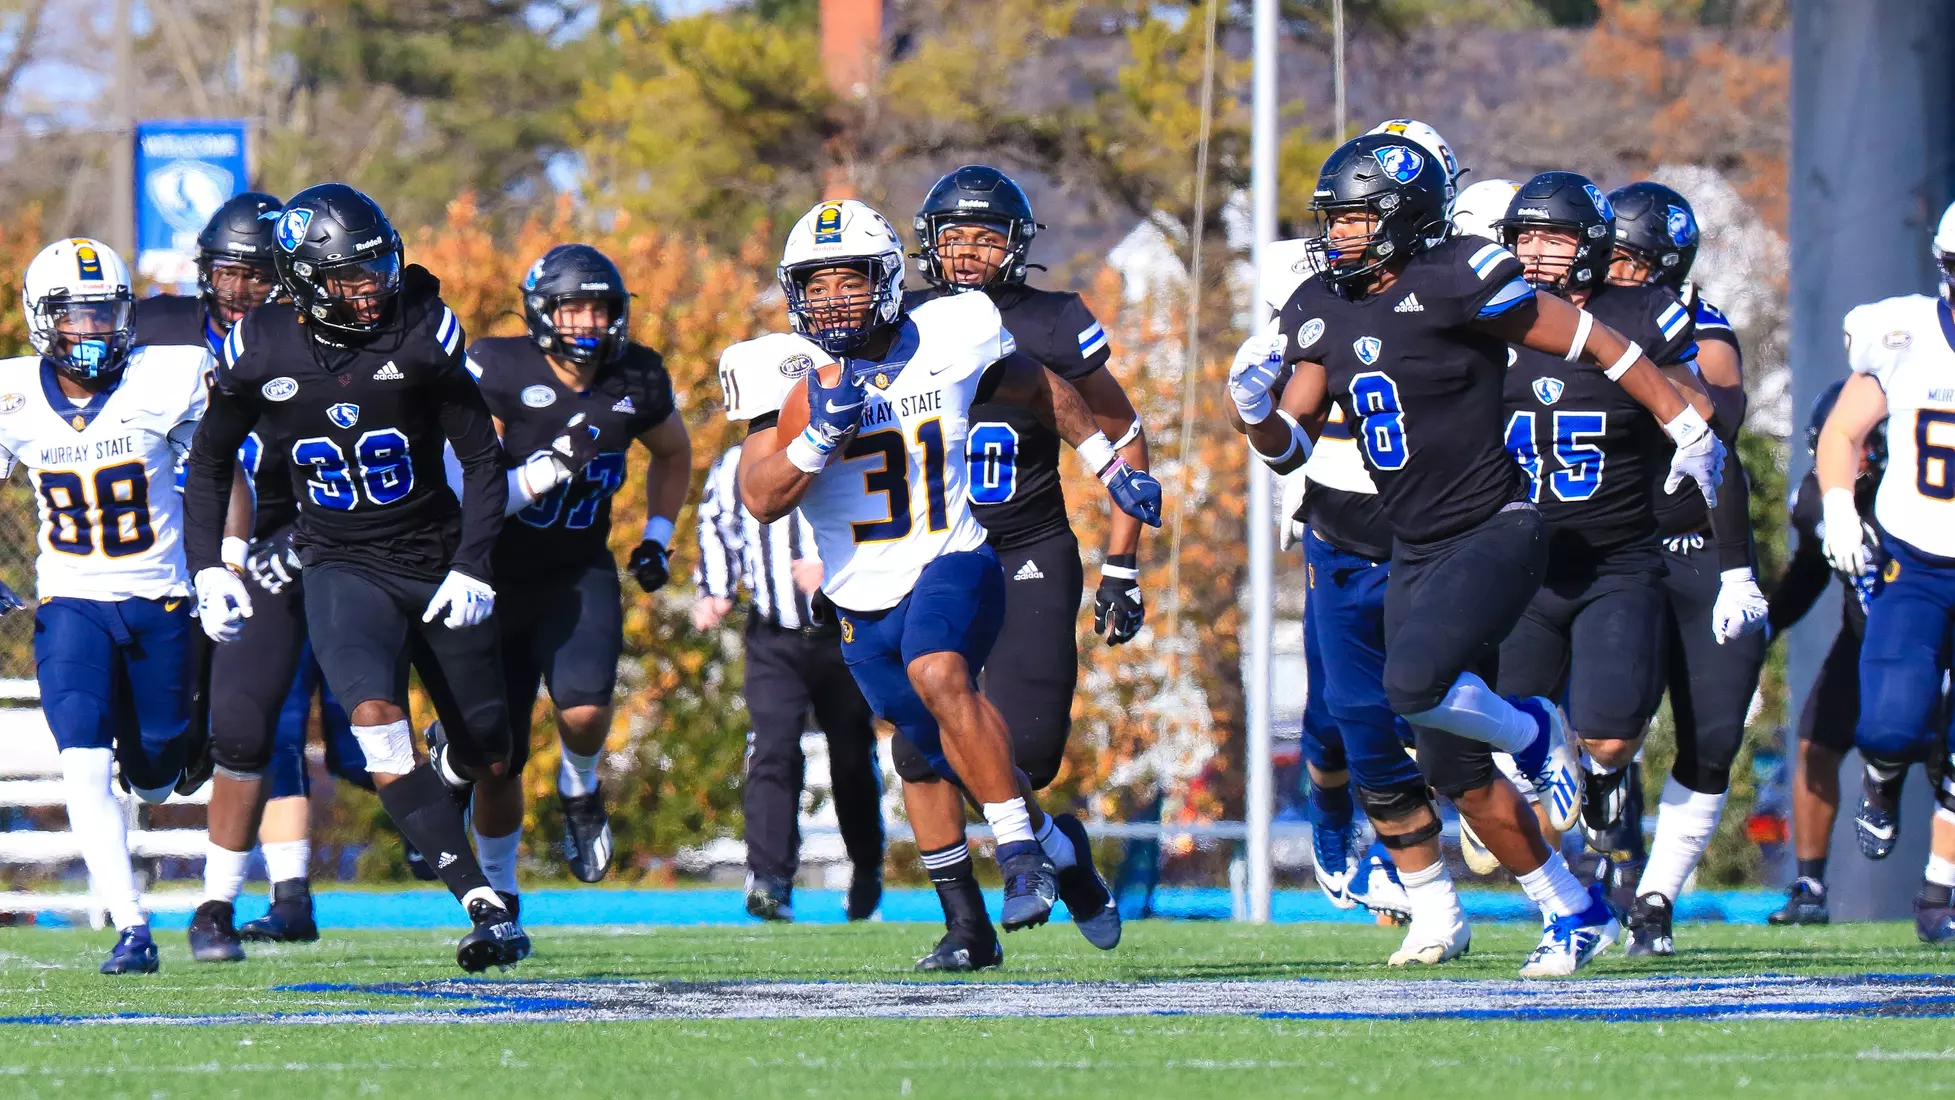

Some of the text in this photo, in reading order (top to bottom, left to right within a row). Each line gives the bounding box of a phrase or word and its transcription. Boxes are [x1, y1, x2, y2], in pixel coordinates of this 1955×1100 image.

[355, 236, 383, 252] Riddell
[1394, 303, 1424, 313] adidas
[373, 371, 404, 381] adidas
[901, 388, 942, 418] STATE
[1349, 370, 1409, 470] 8
[41, 436, 133, 465] MURRAY STATE
[292, 427, 415, 511] 38
[966, 422, 1019, 505] 0
[1504, 410, 1607, 503] 45
[38, 457, 158, 560] 88
[842, 416, 950, 545] 31
[1013, 571, 1044, 581] adidas
